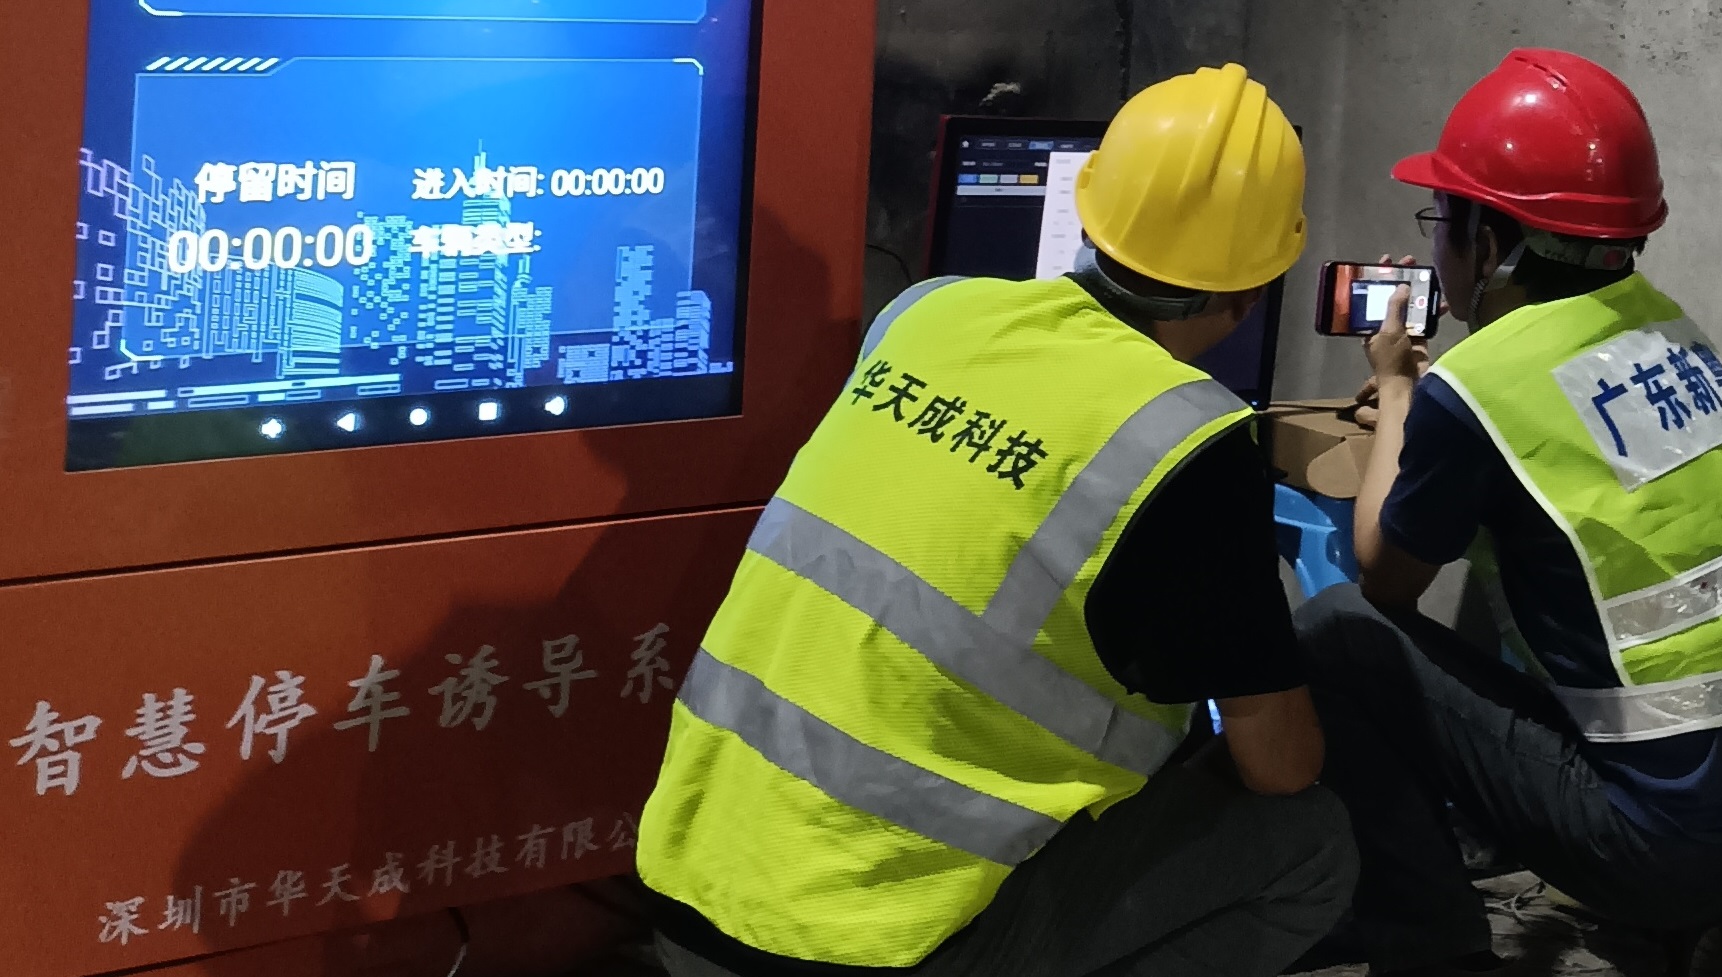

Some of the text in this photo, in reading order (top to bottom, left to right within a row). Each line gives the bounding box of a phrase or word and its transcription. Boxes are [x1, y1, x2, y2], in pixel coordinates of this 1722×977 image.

[194, 160, 357, 204] 停留时间
[550, 167, 666, 198] 00:00:00
[167, 223, 374, 275] 00:00:00
[851, 358, 1050, 491] 华天成科技
[9, 621, 676, 796] 智慧停车诱导系
